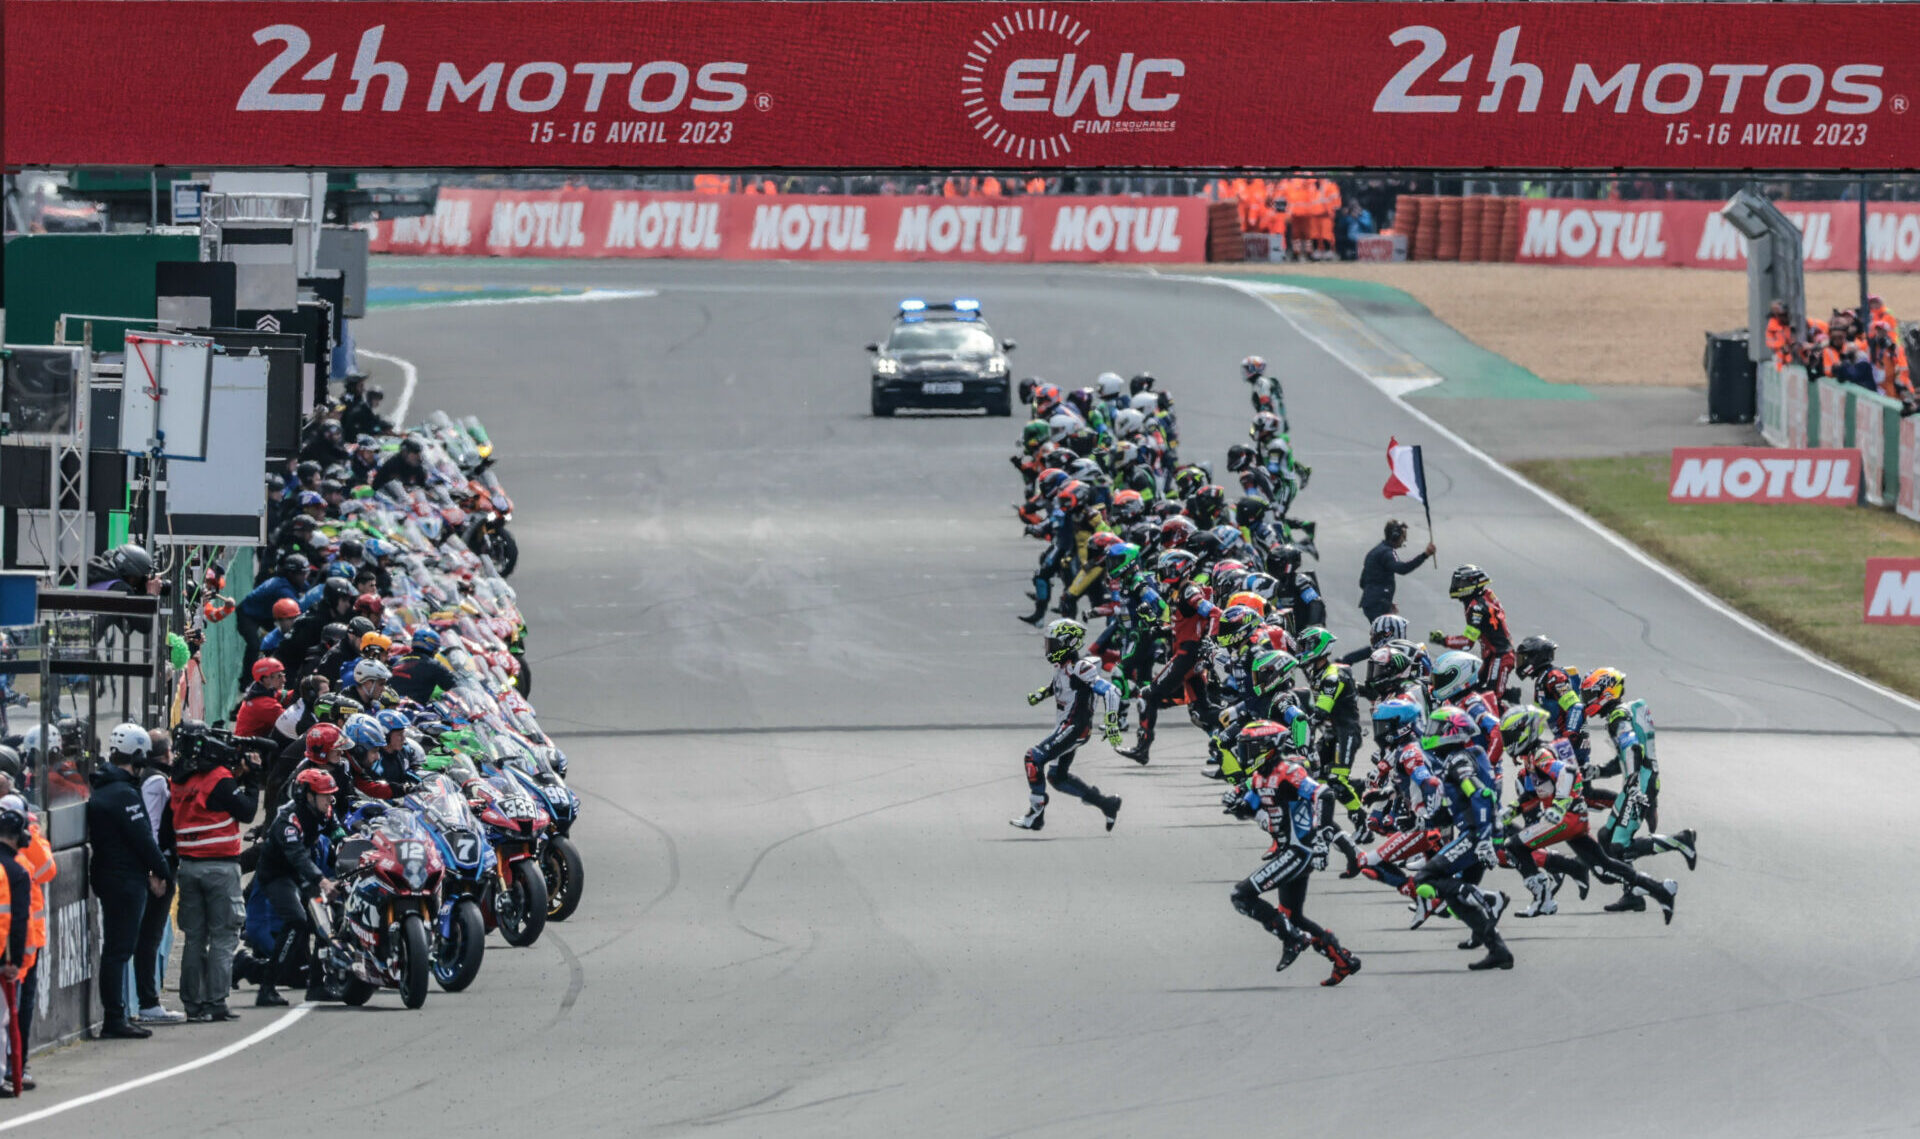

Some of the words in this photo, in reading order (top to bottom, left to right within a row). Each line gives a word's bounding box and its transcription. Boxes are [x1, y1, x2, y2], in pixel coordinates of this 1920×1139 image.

[236, 24, 409, 112] 24h
[999, 52, 1186, 118] EWC
[1372, 25, 1544, 113] 24h
[605, 121, 668, 144] AVRIL
[679, 121, 733, 144] 2023
[1072, 119, 1111, 134] FIM
[1740, 123, 1802, 146] AVRIL
[1812, 123, 1868, 146] 2023
[488, 201, 585, 248] MOTUL
[605, 201, 721, 250] MOTUL
[750, 204, 870, 251] MOTUL
[894, 205, 1027, 253] MOTUL
[1050, 206, 1182, 252] MOTUL
[1520, 208, 1666, 259] MOTUL
[1671, 458, 1855, 498] MOTUL
[504, 798, 537, 819] 333
[400, 841, 425, 860] 12
[457, 839, 476, 860] 7
[1255, 849, 1295, 884] SUZUKI
